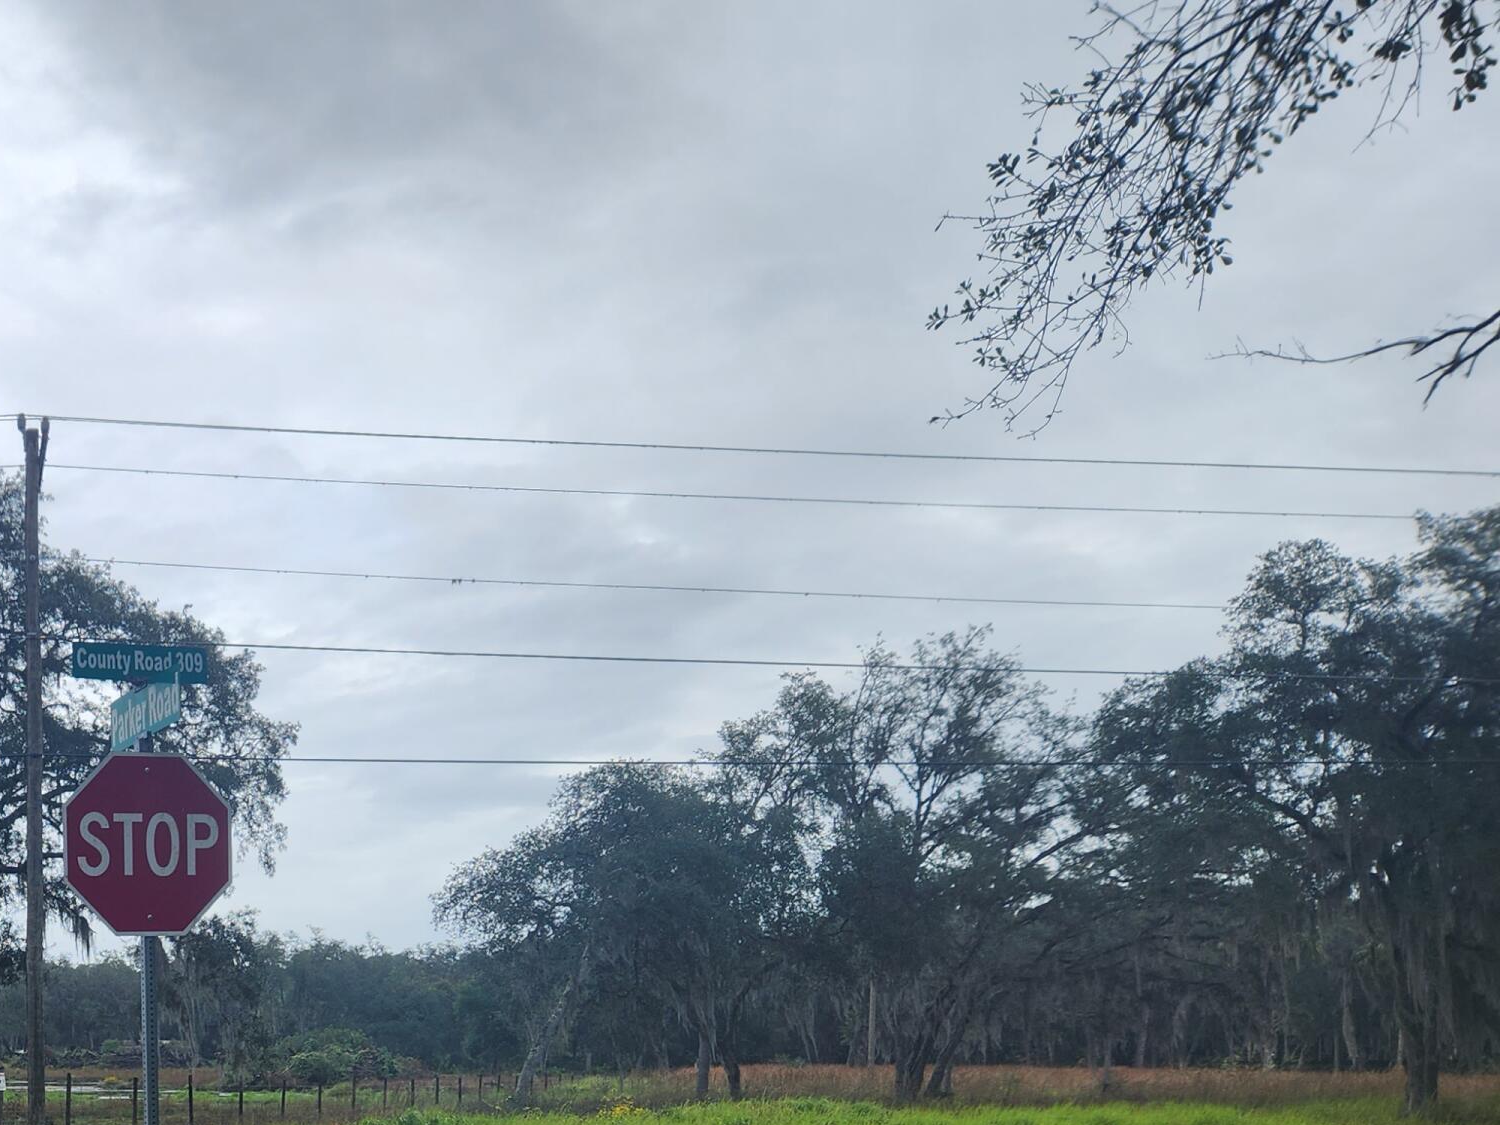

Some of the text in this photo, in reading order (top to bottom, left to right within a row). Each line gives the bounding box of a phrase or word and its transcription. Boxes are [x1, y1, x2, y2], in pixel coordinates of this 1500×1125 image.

[76, 647, 204, 676] County Road 309
[112, 672, 180, 749] Parker Road
[77, 811, 219, 877] STOP
